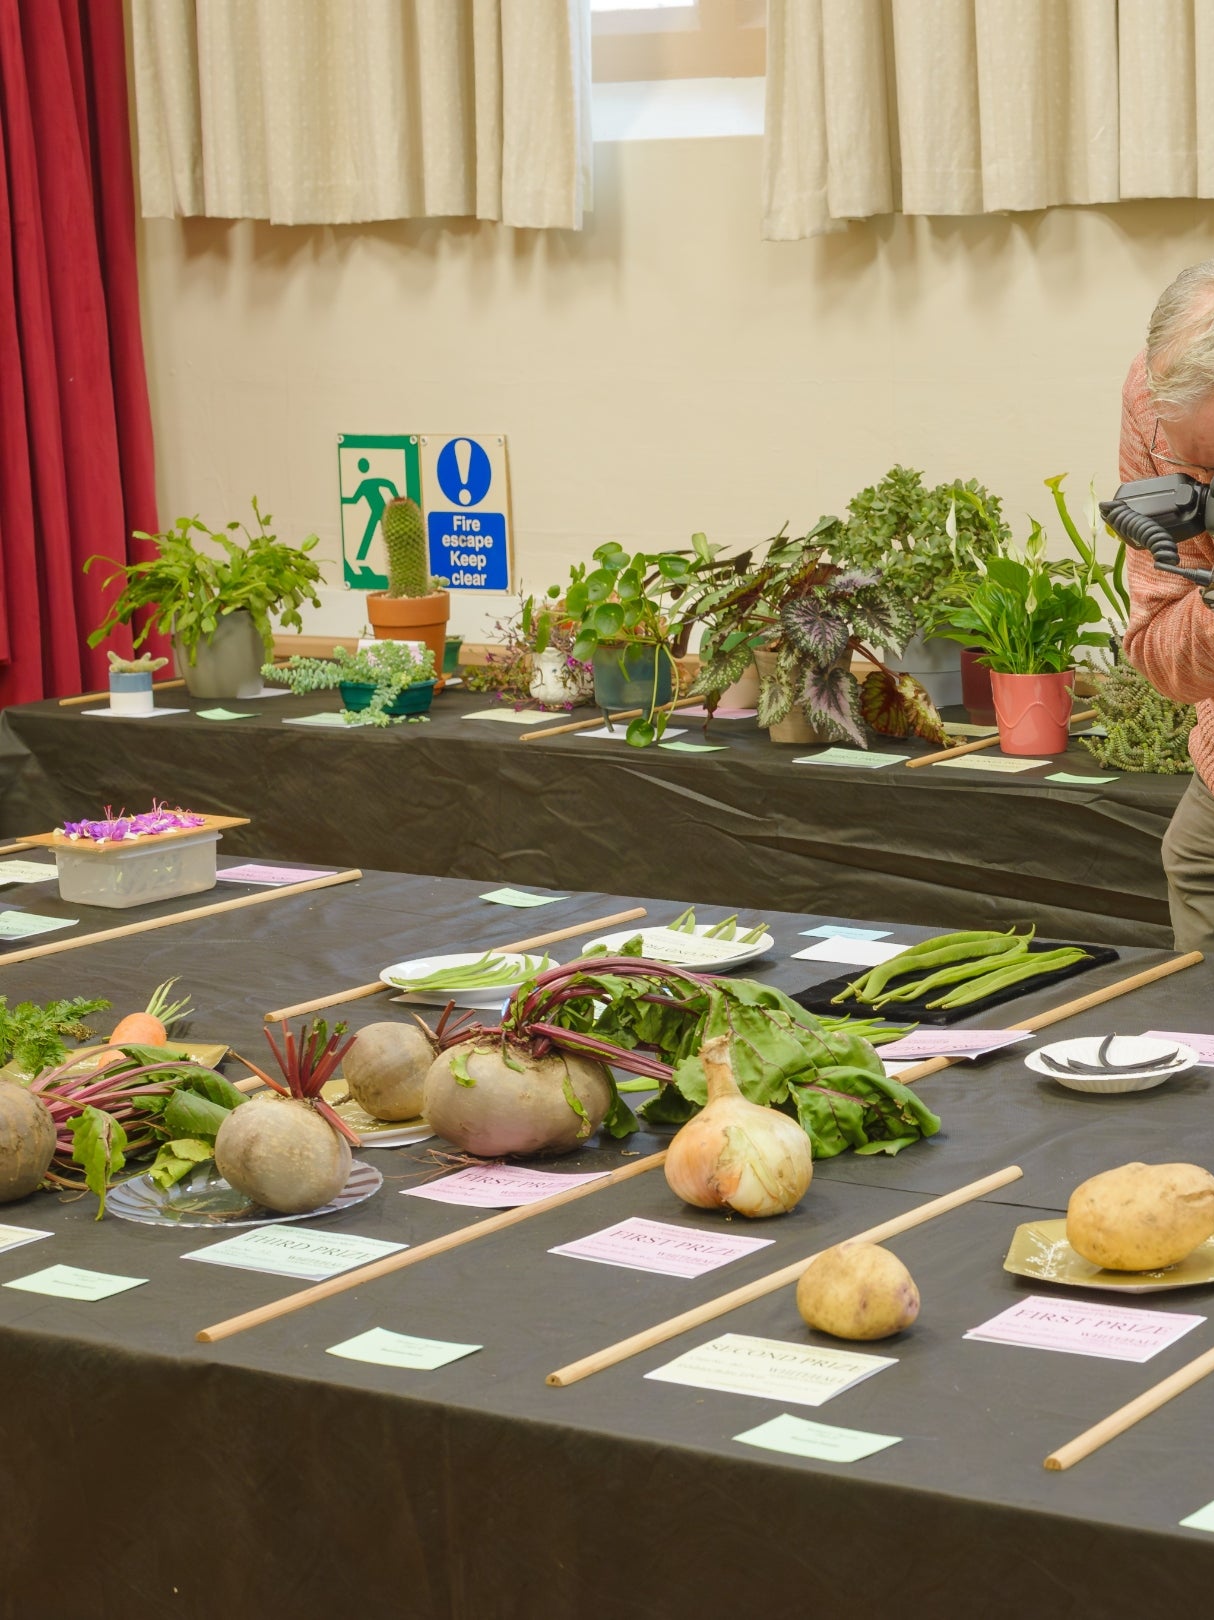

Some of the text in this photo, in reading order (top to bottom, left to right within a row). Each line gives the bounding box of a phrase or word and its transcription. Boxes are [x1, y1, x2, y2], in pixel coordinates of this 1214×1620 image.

[452, 515, 480, 532] Fire
[441, 534, 494, 552] escape
[450, 550, 487, 571] Keep
[451, 569, 487, 586] clear
[458, 1173, 516, 1186] FIRST
[243, 1233, 311, 1251] THIRD
[313, 1244, 371, 1261] PRIZE
[609, 1229, 676, 1248] FIRST
[674, 1240, 742, 1257] PRIZE
[1012, 1308, 1089, 1326] FIRST
[1092, 1319, 1173, 1335] PRIZE
[1080, 1331, 1161, 1346] WHITEHALL
[704, 1343, 868, 1373] SECOND PRIZE
